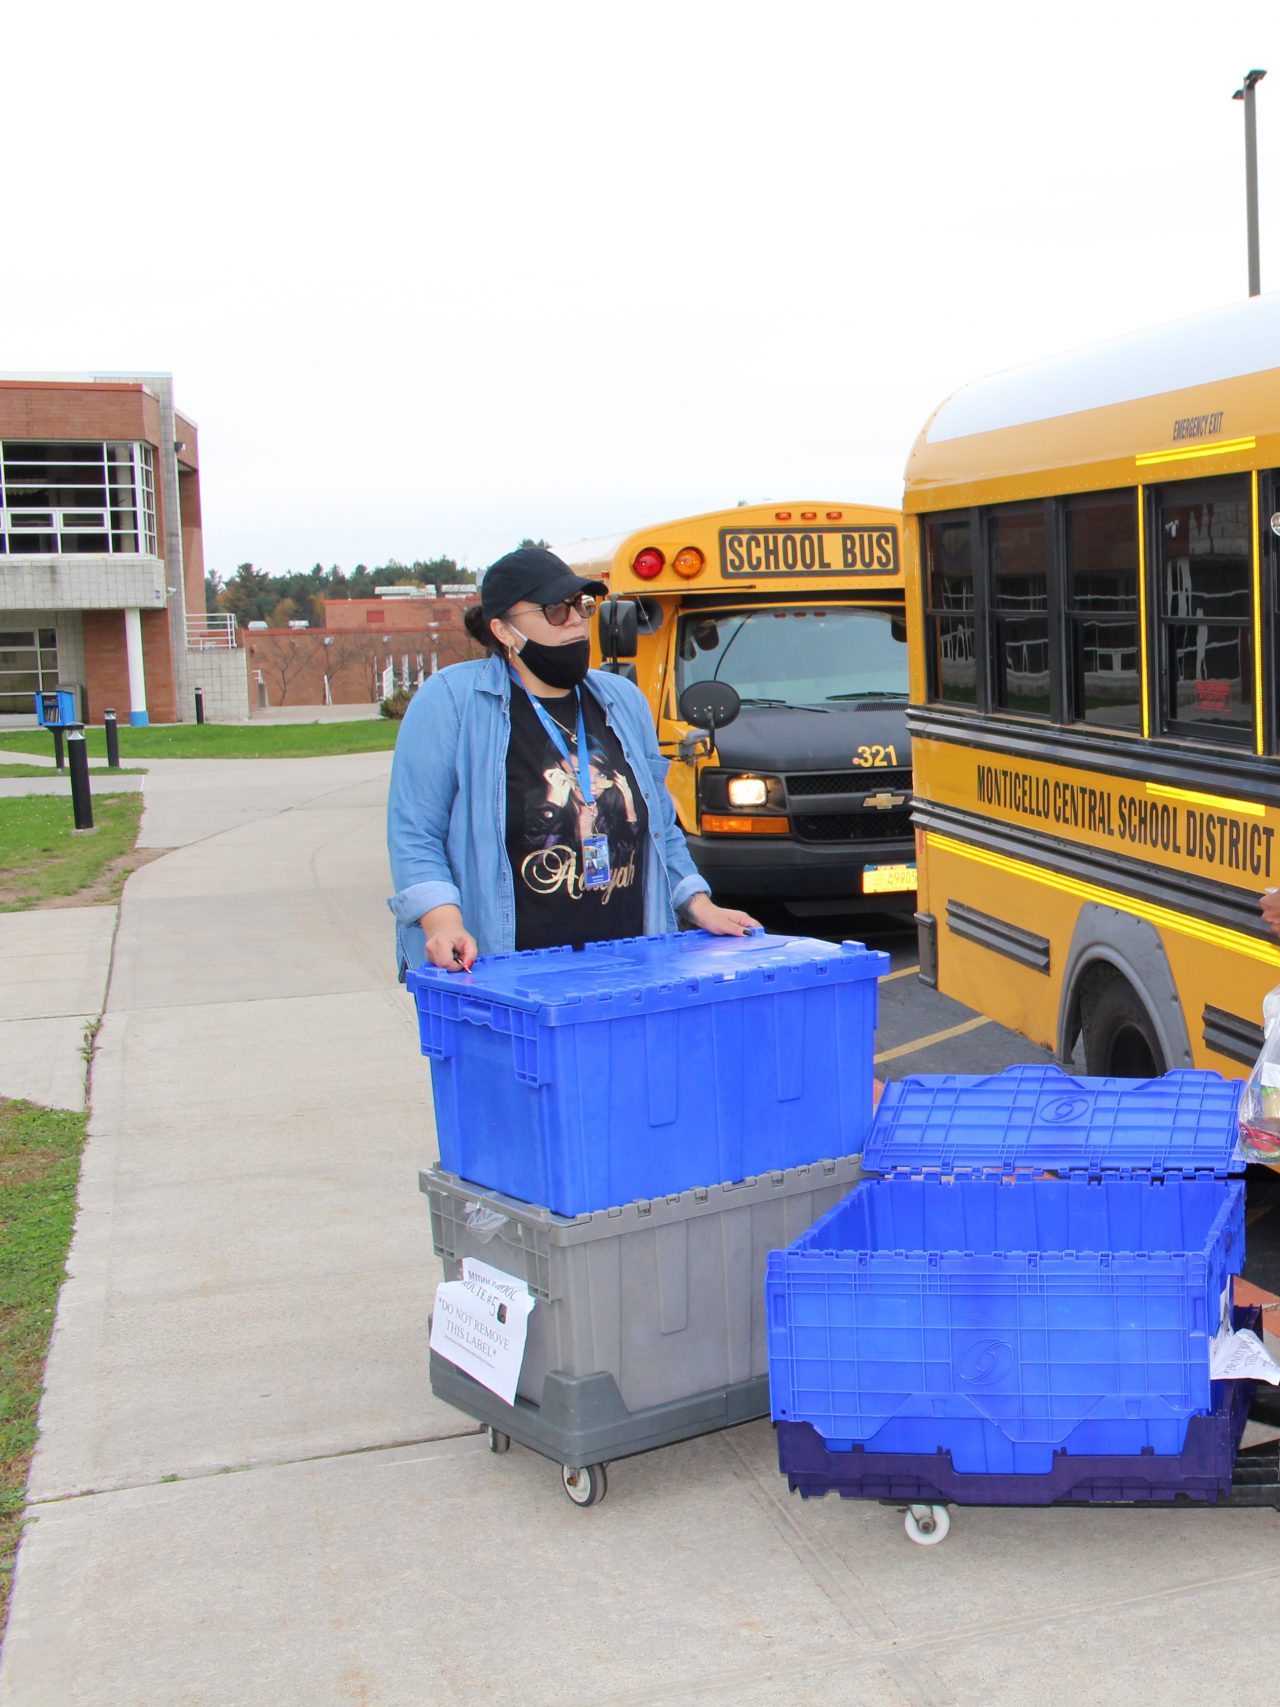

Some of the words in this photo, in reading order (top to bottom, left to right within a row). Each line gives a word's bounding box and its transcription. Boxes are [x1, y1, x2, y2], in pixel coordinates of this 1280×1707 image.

[1173, 413, 1209, 440] EMERGENCY
[1208, 411, 1223, 435] EXIT
[728, 533, 832, 571] SCHOOL
[841, 533, 892, 569] BUS
[857, 745, 897, 767] 321
[977, 765, 1050, 819] MONTICELLO
[1053, 781, 1114, 836] CENTRAL
[1118, 794, 1181, 854] SCHOOL
[1186, 810, 1274, 878] DISTRICT
[521, 844, 635, 905] Aayah
[446, 1318, 464, 1339] THIS
[455, 1308, 472, 1327] NOT
[474, 1319, 509, 1350] REMOVE
